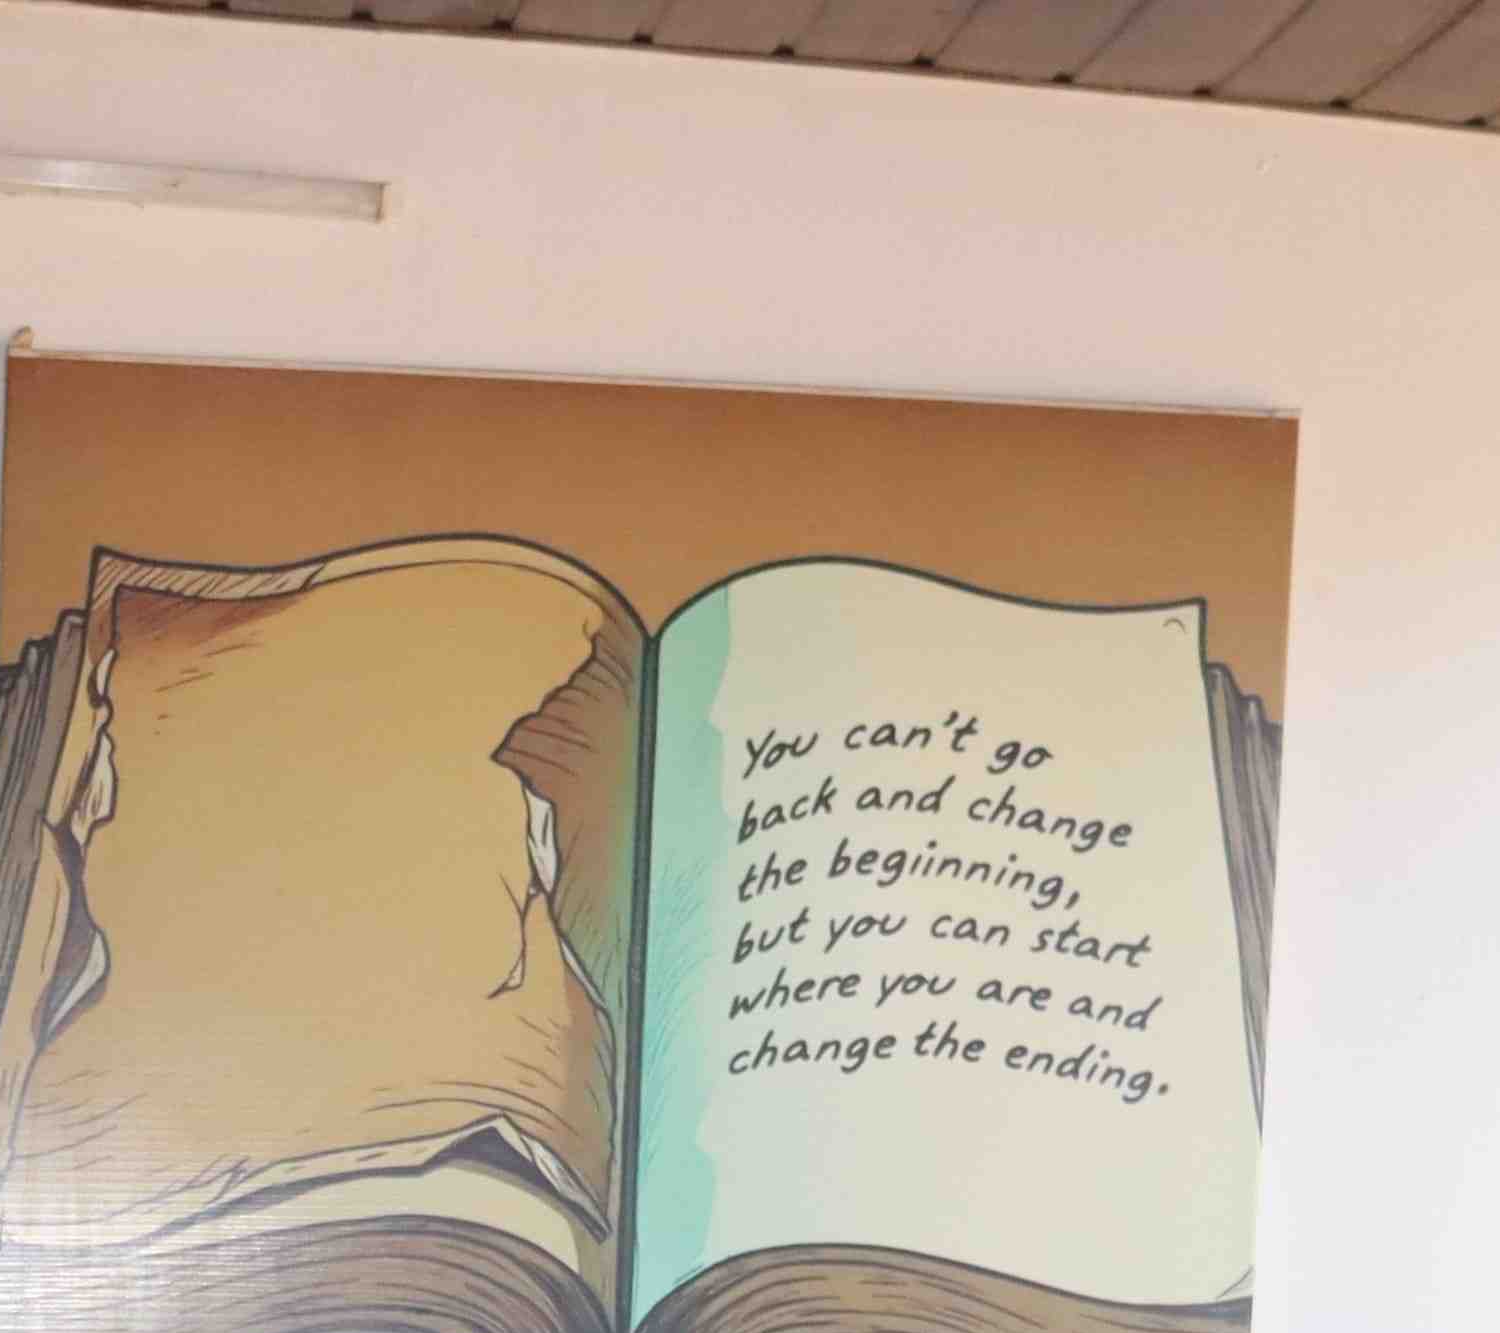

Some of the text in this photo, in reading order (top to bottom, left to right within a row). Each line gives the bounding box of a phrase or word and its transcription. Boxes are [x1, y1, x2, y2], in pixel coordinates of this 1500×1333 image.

[742, 709, 1054, 778] You can't go
[737, 773, 1133, 853] back and change
[737, 851, 808, 903] the
[732, 907, 1152, 968] but you can start
[728, 966, 1164, 1032] where you are and
[728, 1019, 1169, 1105] change the ending.
